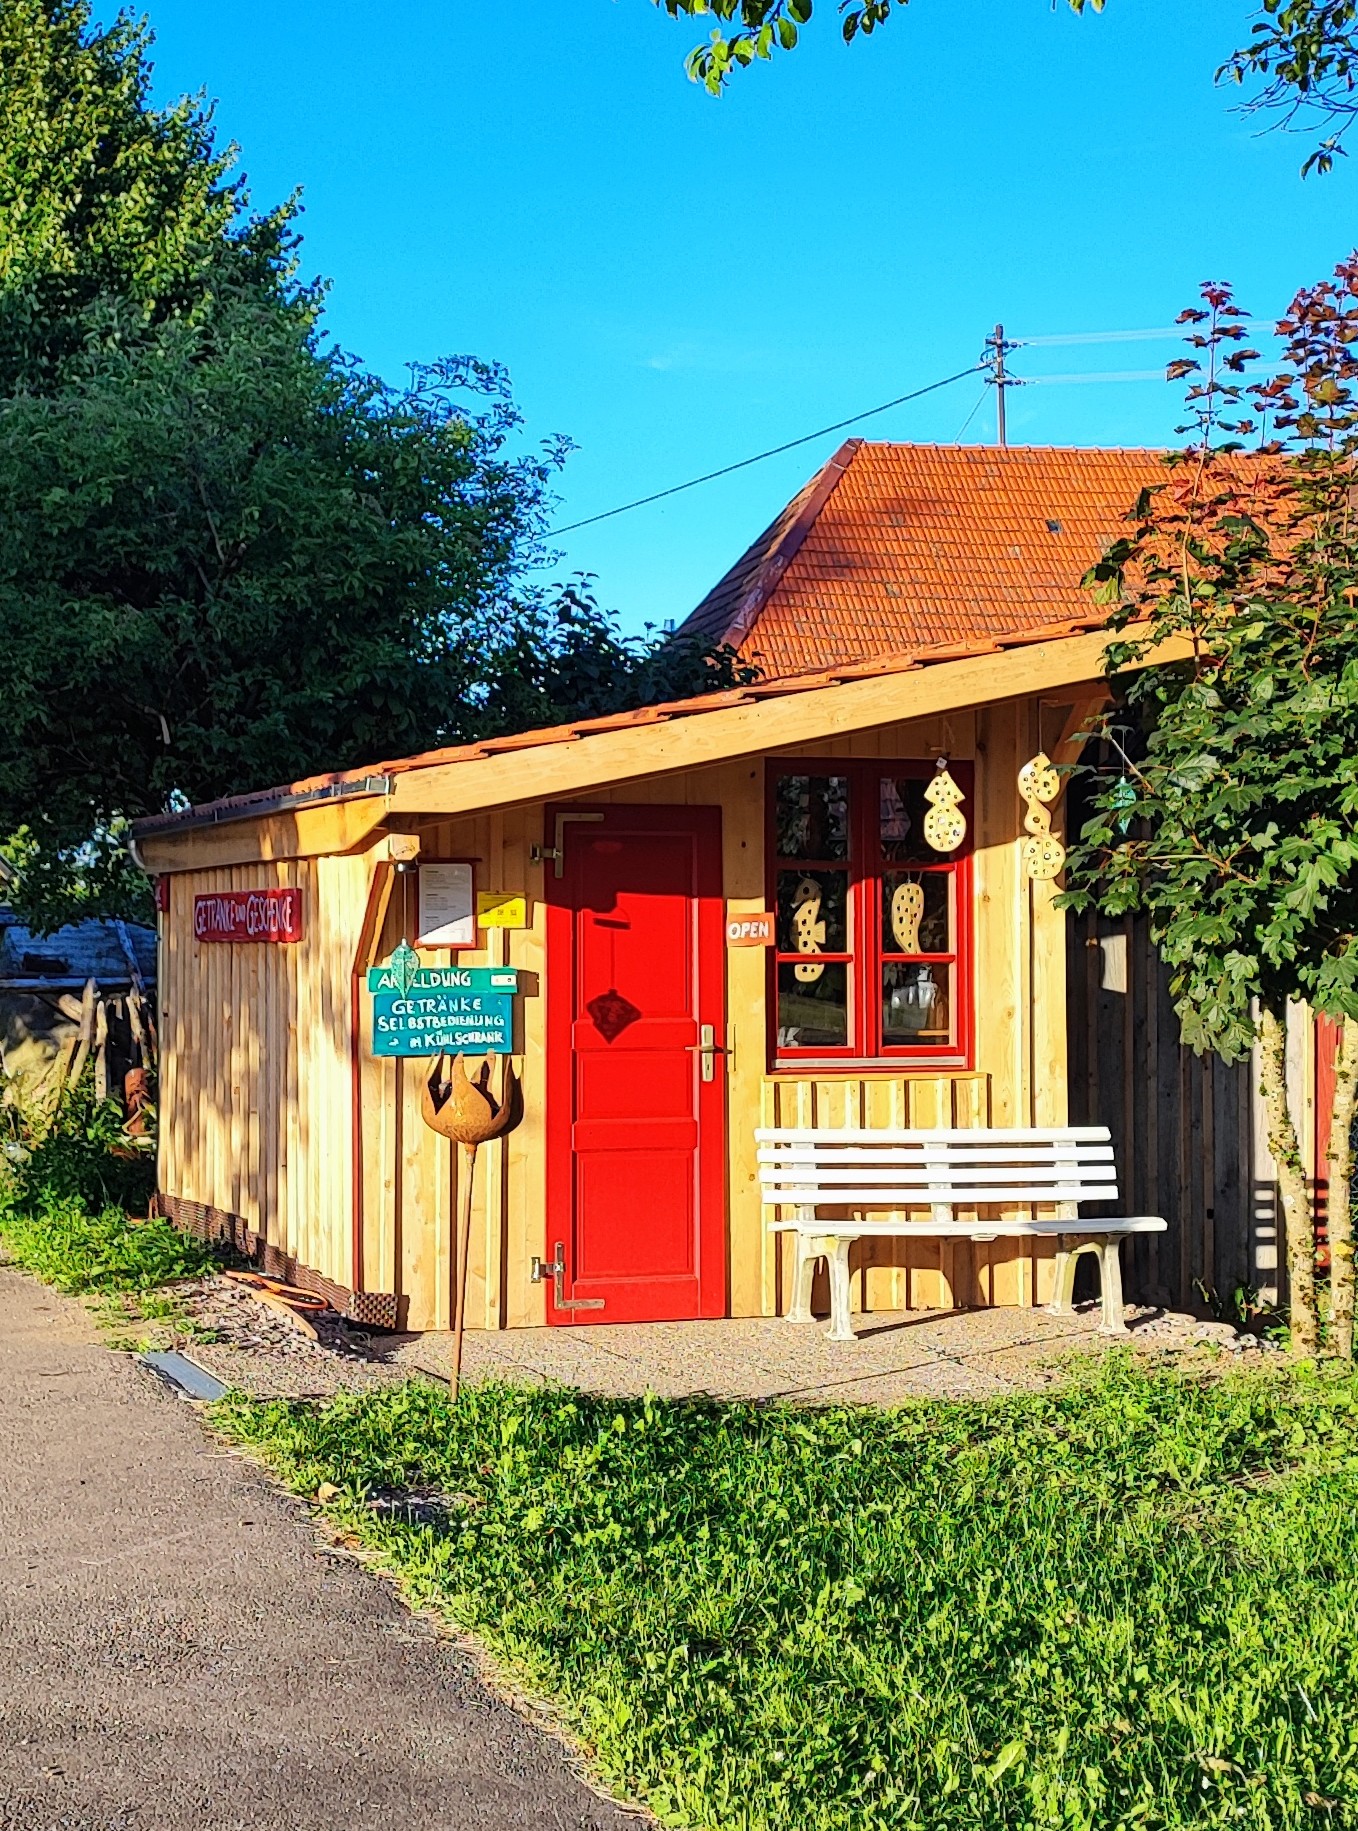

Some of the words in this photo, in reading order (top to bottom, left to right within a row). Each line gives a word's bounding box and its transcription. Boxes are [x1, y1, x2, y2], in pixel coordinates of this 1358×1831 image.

[247, 894, 293, 936] GESCHENKE
[728, 920, 769, 940] OPEN
[391, 994, 482, 1015] GETRÄNKE
[377, 1014, 505, 1032] SELBSTBEDIENUNG
